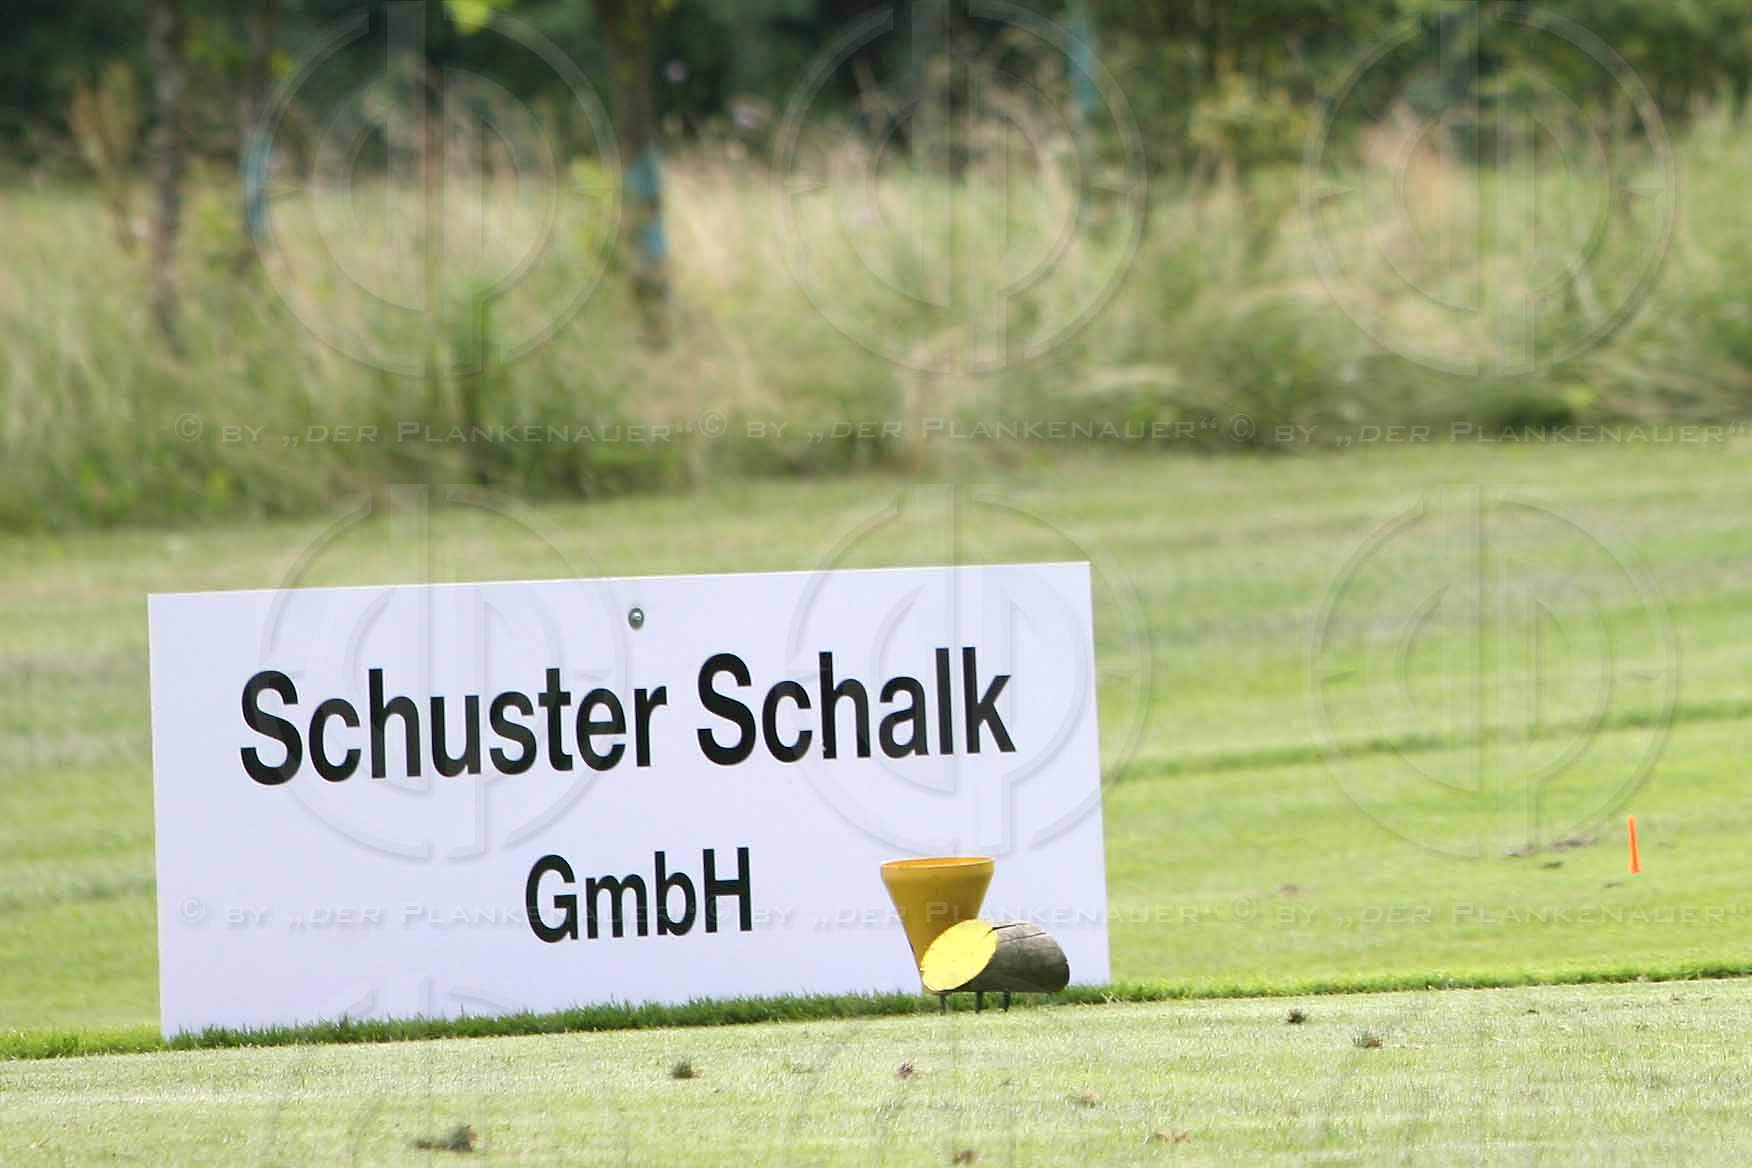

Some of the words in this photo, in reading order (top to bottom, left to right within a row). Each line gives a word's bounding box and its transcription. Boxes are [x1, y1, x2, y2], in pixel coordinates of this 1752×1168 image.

[241, 668, 667, 785] Schuster
[698, 647, 1015, 765] Schalk
[526, 847, 751, 943] GmbH
